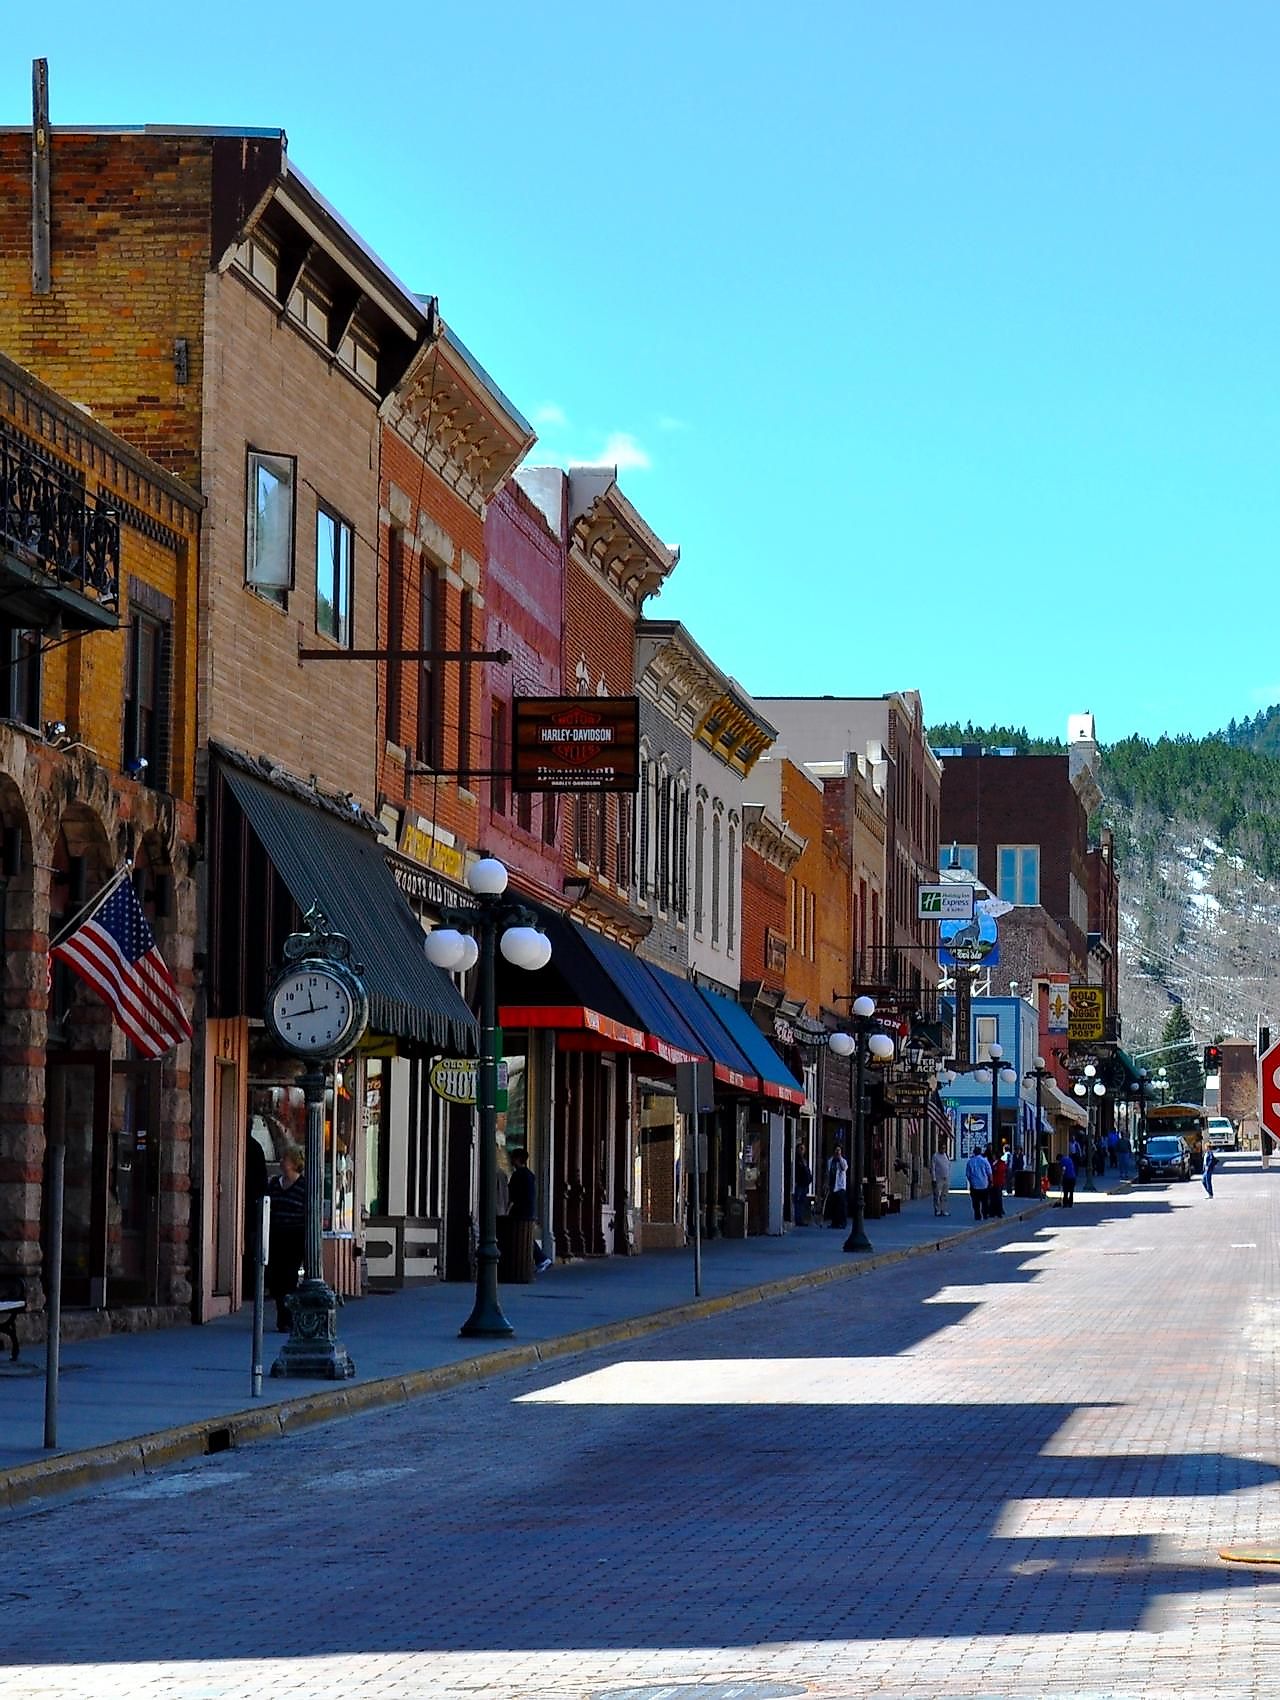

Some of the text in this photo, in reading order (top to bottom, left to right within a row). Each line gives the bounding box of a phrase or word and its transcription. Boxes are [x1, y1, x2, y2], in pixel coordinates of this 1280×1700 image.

[541, 729, 611, 741] HARLEY-DAVIDSON
[296, 983, 303, 991] 11
[309, 978, 317, 987] 12
[286, 993, 294, 1001] 10
[1071, 991, 1096, 1001] GOLD
